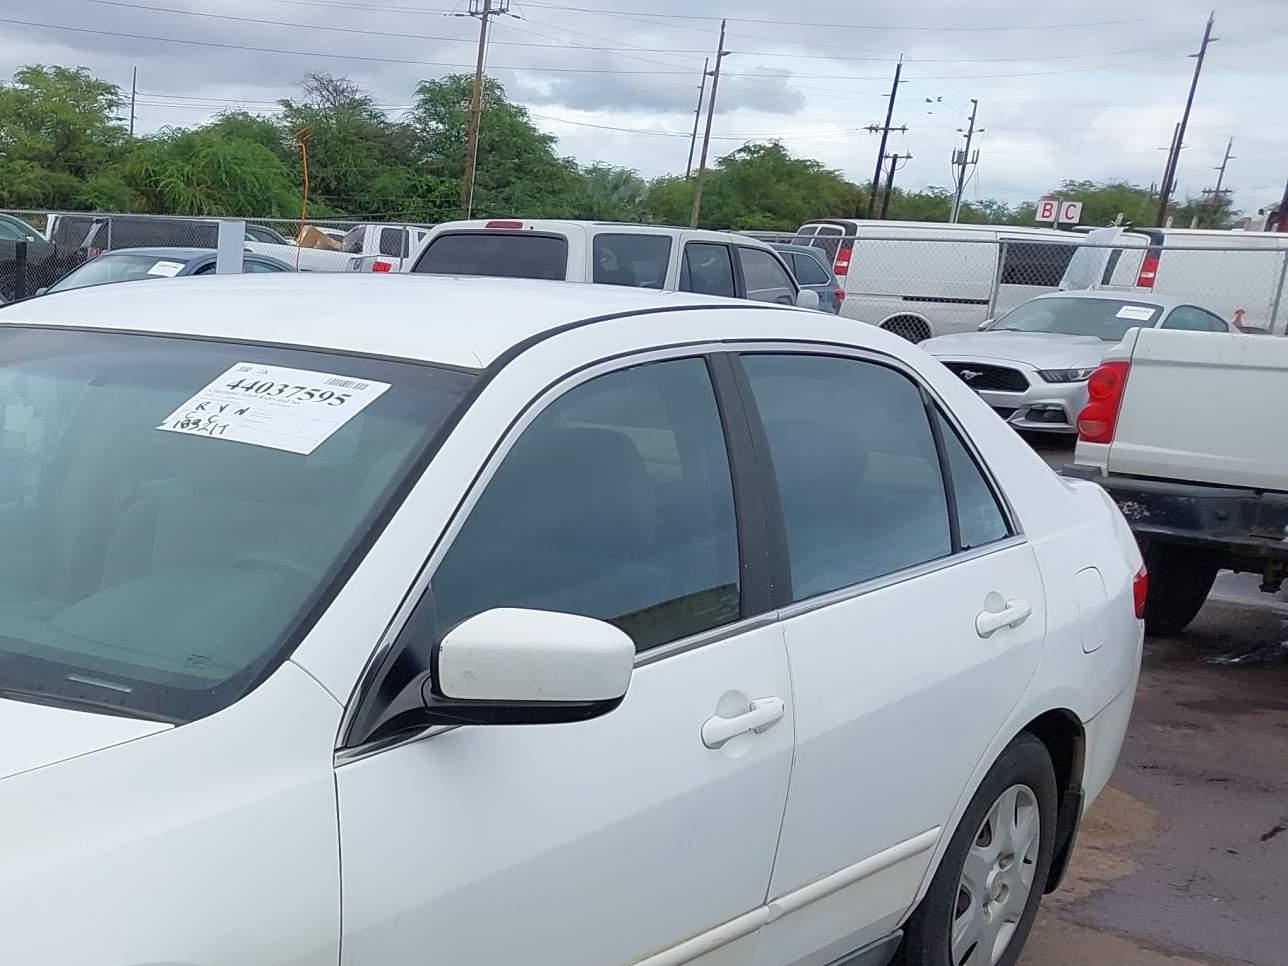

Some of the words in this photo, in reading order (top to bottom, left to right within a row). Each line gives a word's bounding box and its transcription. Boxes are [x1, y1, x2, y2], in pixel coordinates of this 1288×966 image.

[1041, 202, 1054, 218] B
[1065, 204, 1077, 220] C
[225, 377, 352, 407] 44037595
